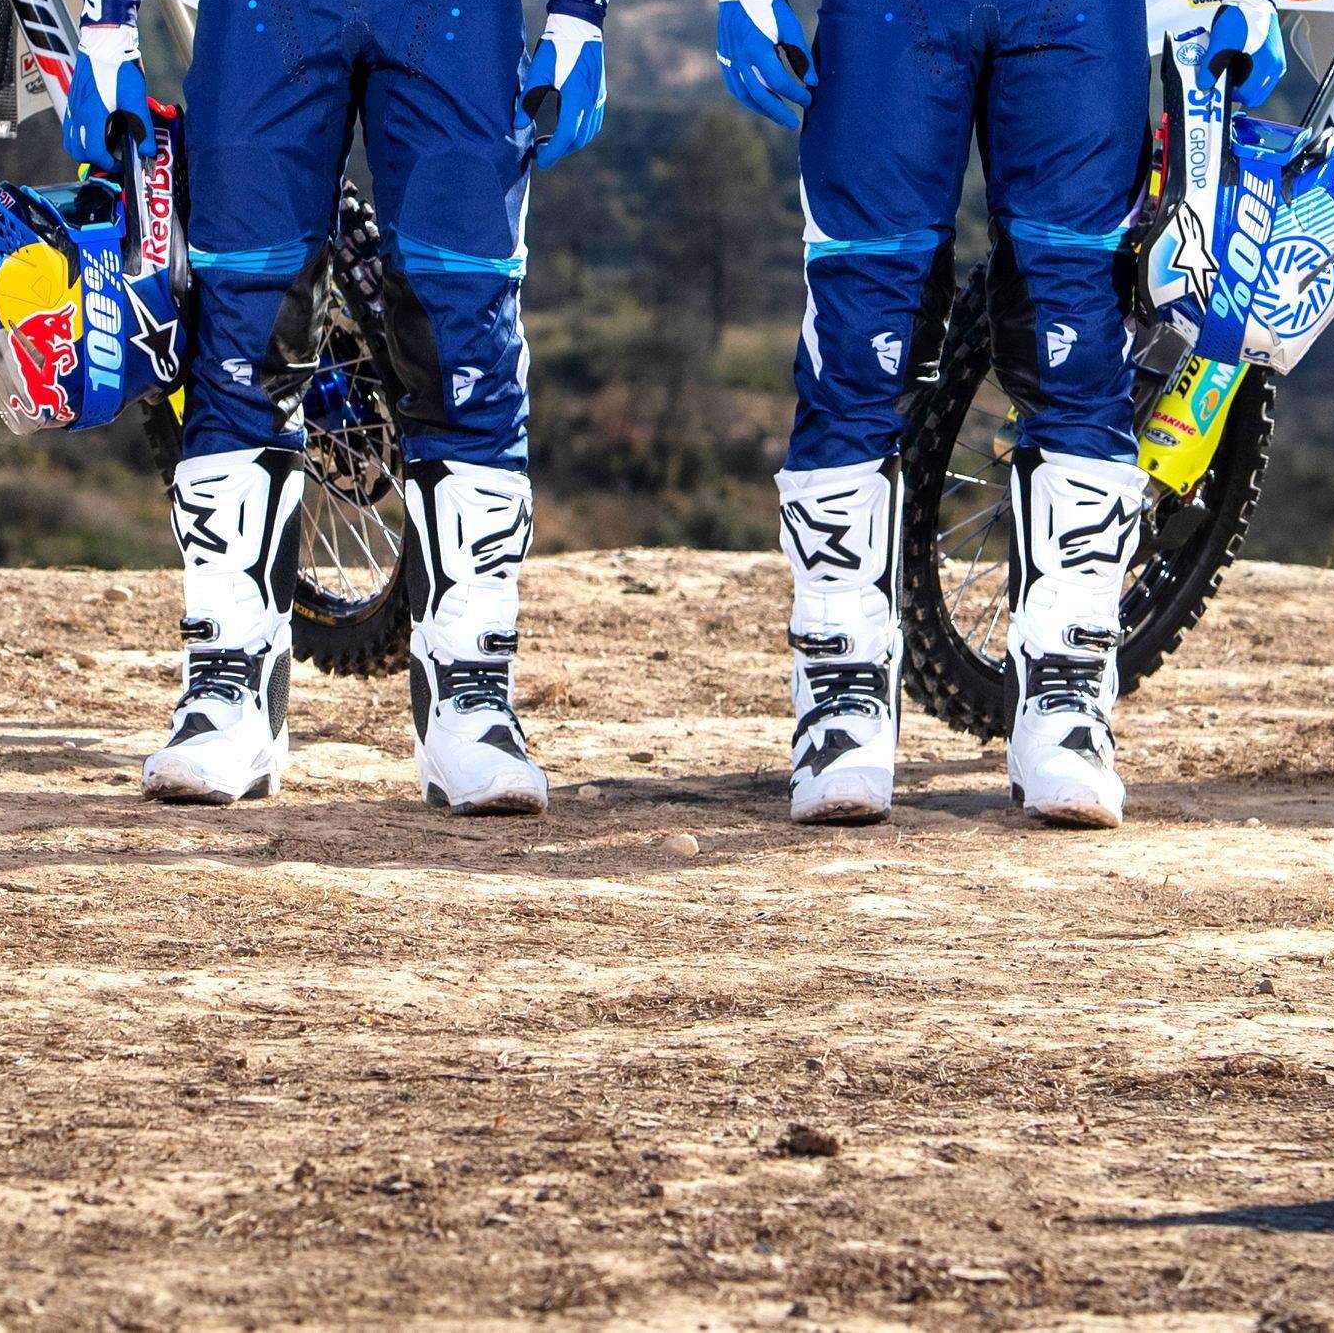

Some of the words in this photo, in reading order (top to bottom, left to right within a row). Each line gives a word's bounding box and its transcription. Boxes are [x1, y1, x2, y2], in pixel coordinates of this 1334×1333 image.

[1188, 87, 1222, 123] SF
[1189, 129, 1208, 190] GROUP
[83, 249, 123, 392] 100%
